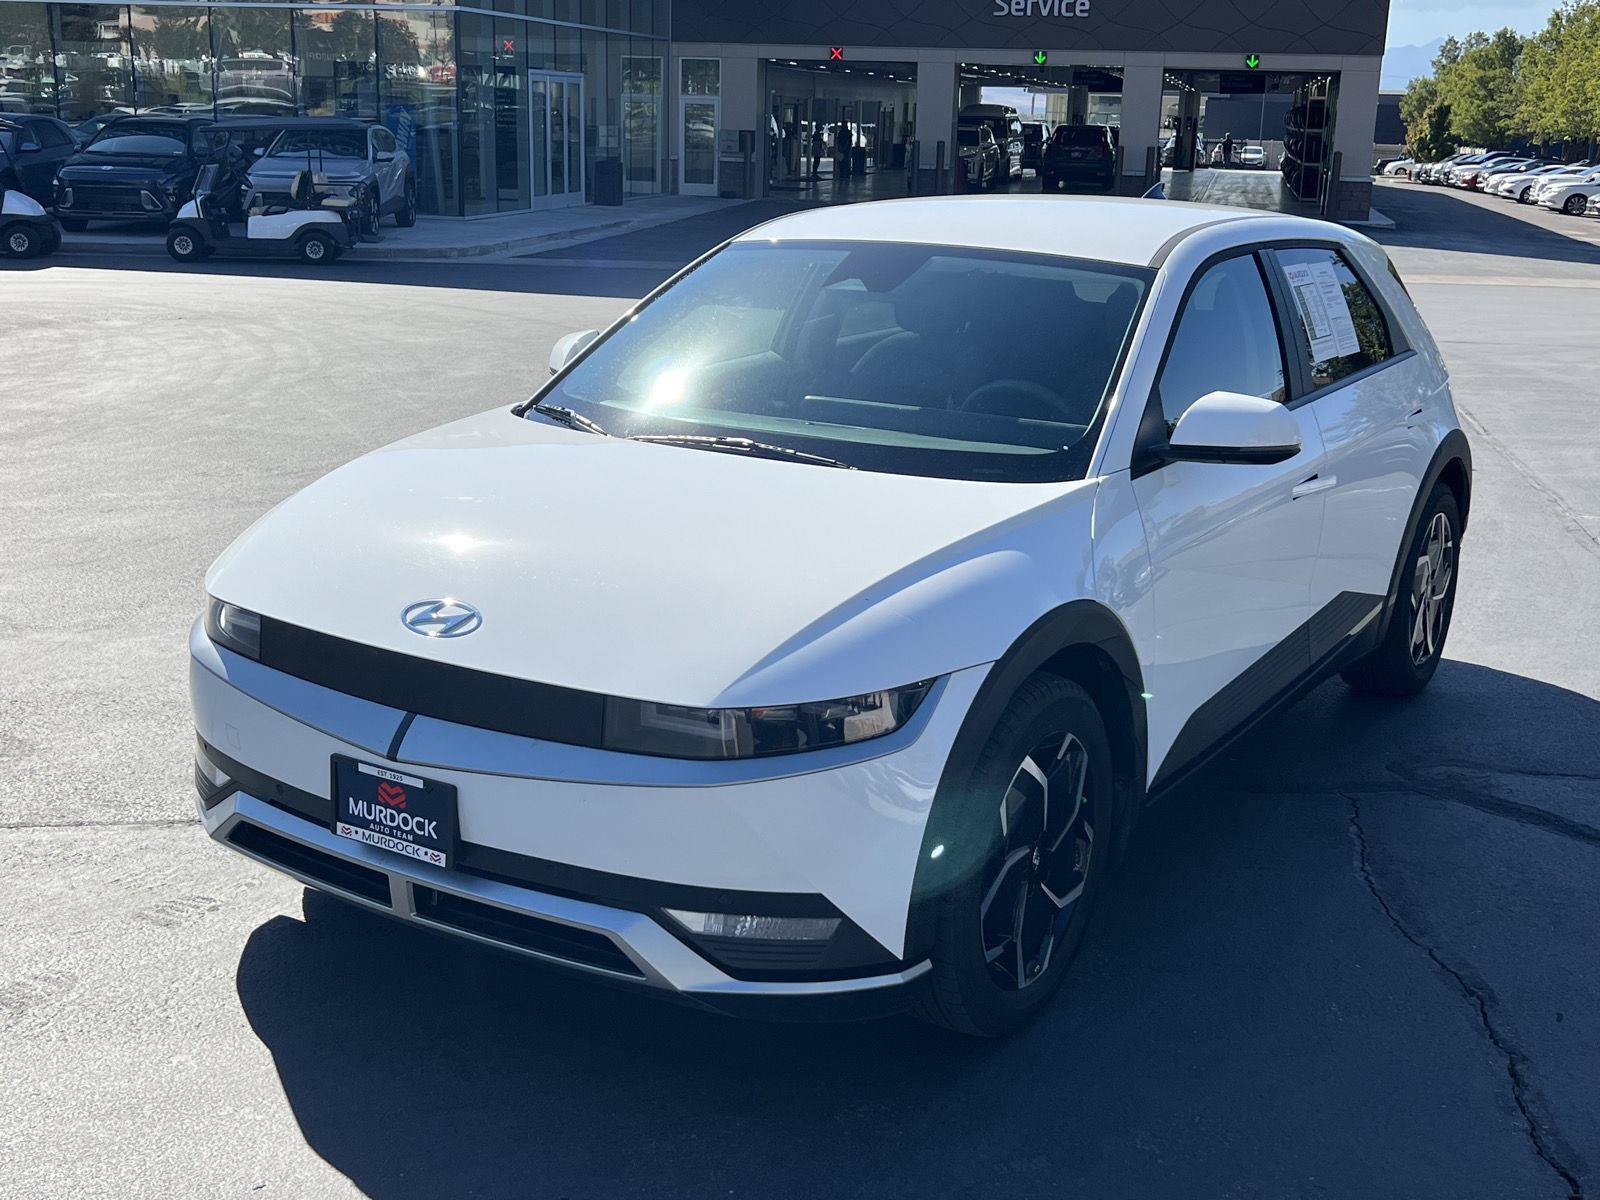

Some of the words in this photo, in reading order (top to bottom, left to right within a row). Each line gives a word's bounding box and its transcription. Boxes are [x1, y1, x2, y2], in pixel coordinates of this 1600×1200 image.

[993, 0, 1091, 17] Service
[389, 773, 403, 782] 1925
[349, 797, 438, 840] MURDOCK
[369, 822, 390, 834] AUTO
[393, 829, 414, 841] TEAM
[361, 830, 421, 858] MURDOCK
